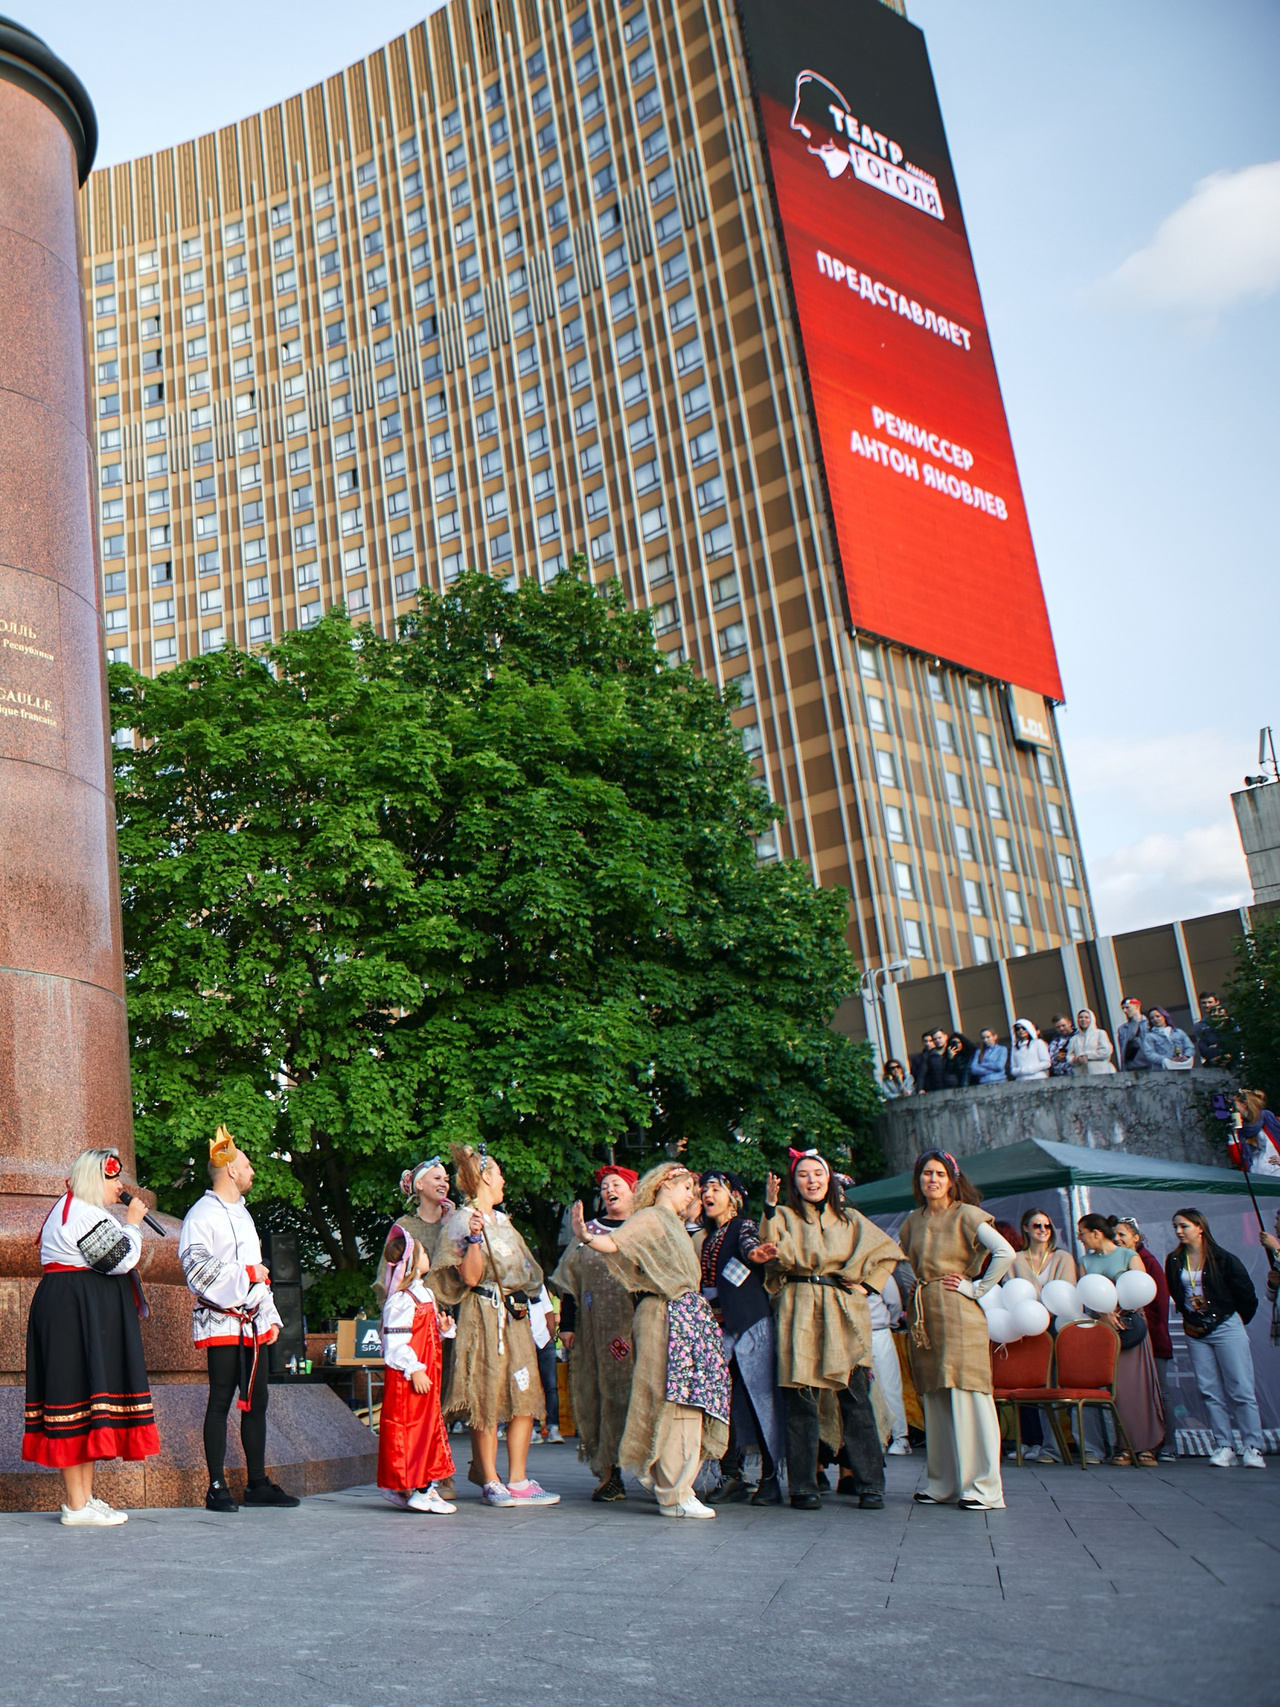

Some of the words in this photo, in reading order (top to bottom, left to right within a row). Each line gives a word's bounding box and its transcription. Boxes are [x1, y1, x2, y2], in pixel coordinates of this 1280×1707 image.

[828, 104, 904, 165] ТЕАТР
[816, 250, 971, 351] ПРЕДСТАВЛЯЕТ
[850, 430, 920, 481] АНТОН
[922, 463, 1008, 521] ЯКОВЛЕВ
[871, 405, 974, 471] РЕЖИССЕР
